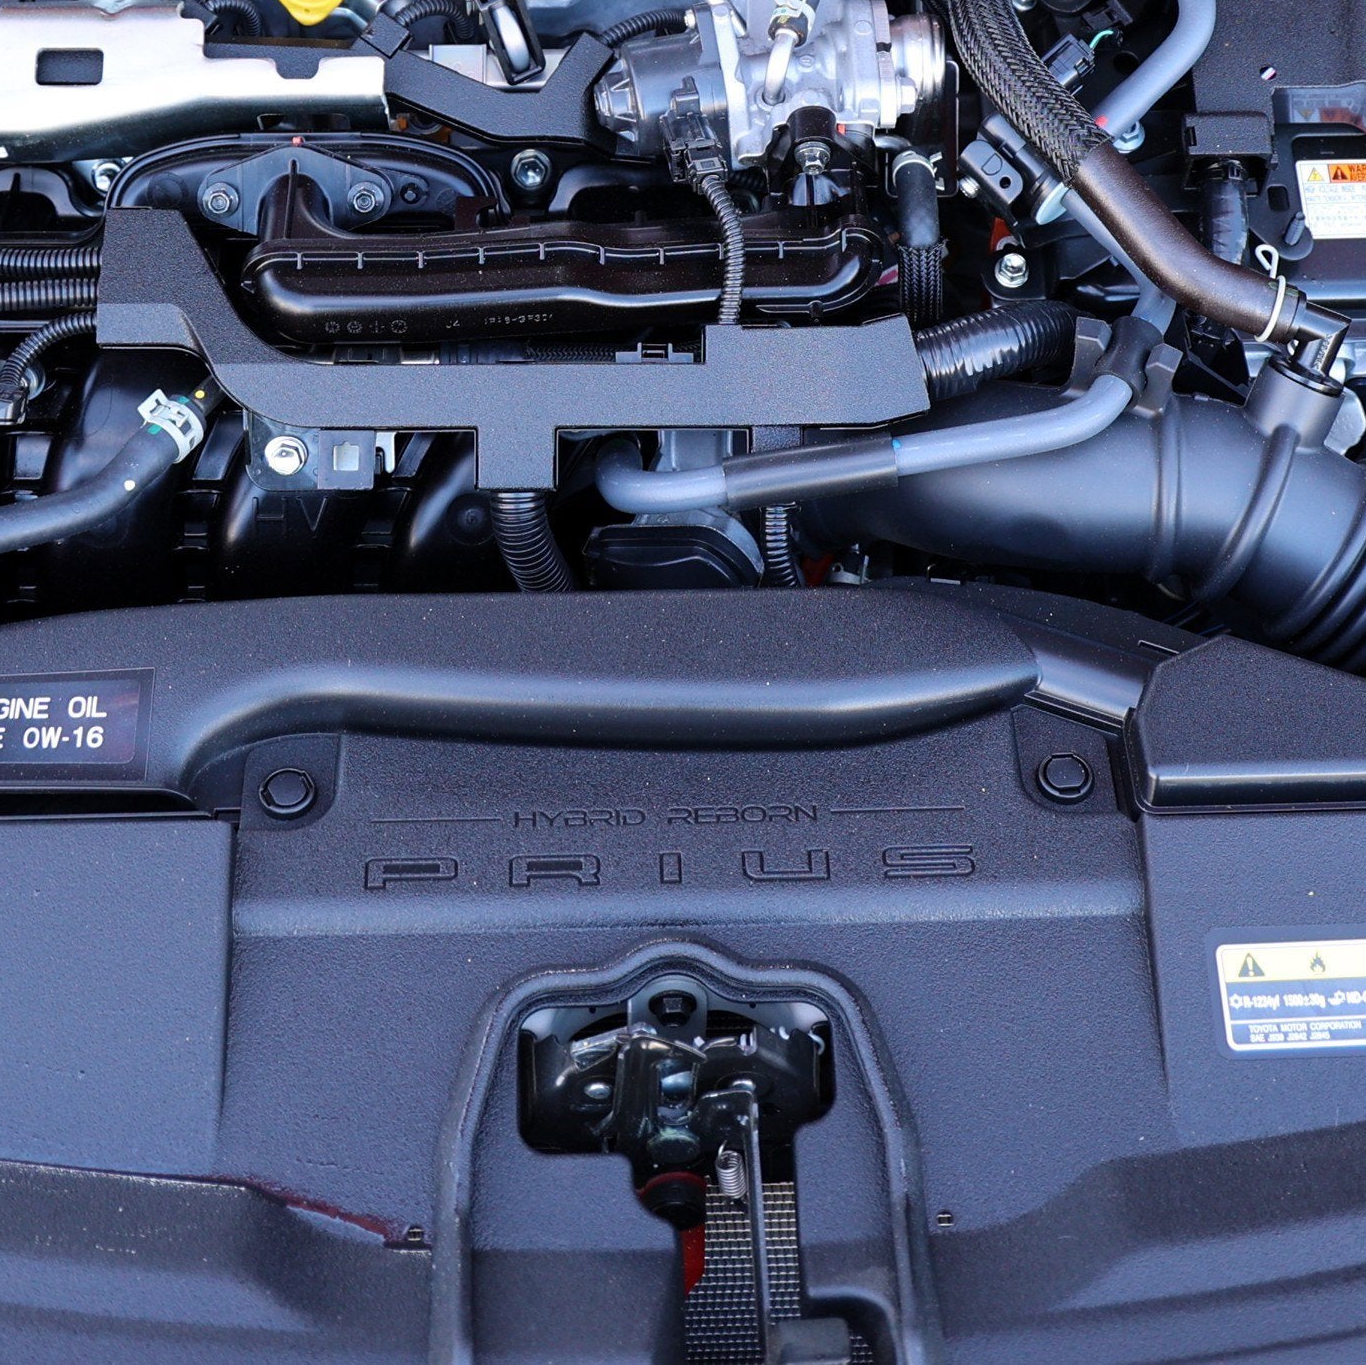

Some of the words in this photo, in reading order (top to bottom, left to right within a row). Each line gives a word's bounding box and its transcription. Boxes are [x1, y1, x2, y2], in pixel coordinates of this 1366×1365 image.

[68, 696, 107, 719] OIL
[23, 725, 104, 749] 0W-16
[515, 807, 646, 828] HYBRID
[668, 804, 818, 825] REBORN
[364, 844, 975, 890] PRIUS
[1249, 1024, 1278, 1033] TOYOTA
[1281, 1022, 1307, 1032] MOTOR
[1310, 1020, 1362, 1031] CORPORATION
[1250, 1033, 1265, 1043] SAE
